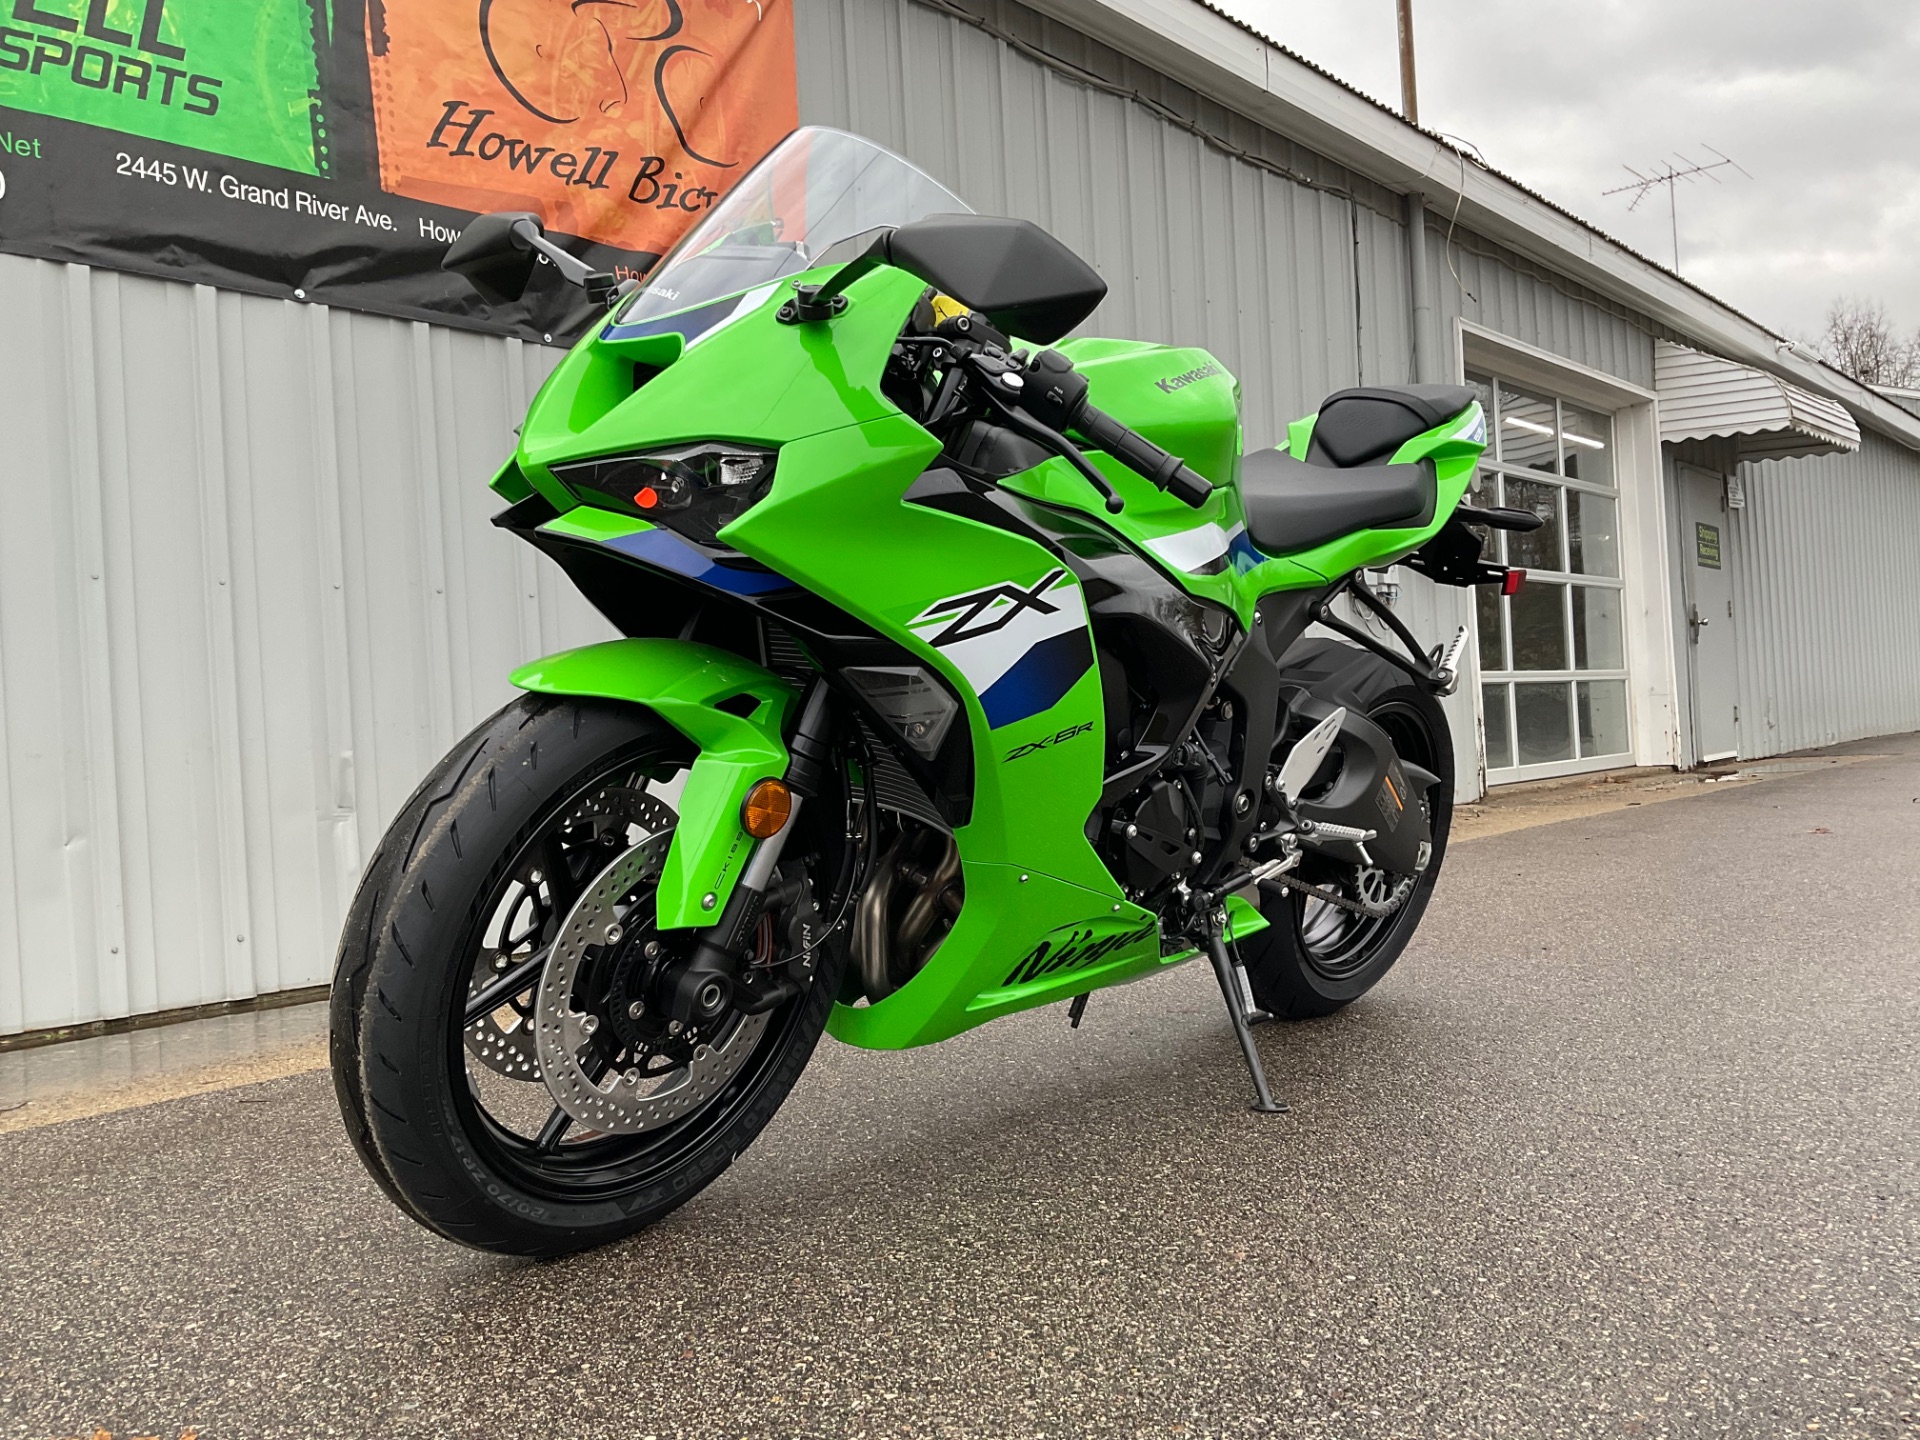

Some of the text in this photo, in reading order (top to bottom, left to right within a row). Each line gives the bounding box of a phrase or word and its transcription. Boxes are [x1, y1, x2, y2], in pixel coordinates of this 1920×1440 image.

[0, 26, 223, 116] SPORTS
[426, 100, 619, 190] Howell
[116, 152, 177, 186] 2445
[182, 166, 213, 194] W.
[219, 175, 289, 210] Grand
[295, 191, 349, 222] River
[355, 204, 399, 232] Ave.
[920, 567, 1067, 648] ZX
[1002, 720, 1094, 763] ZX-6R
[1001, 913, 1157, 987] Ninja
[486, 1183, 551, 1221] 120/70
